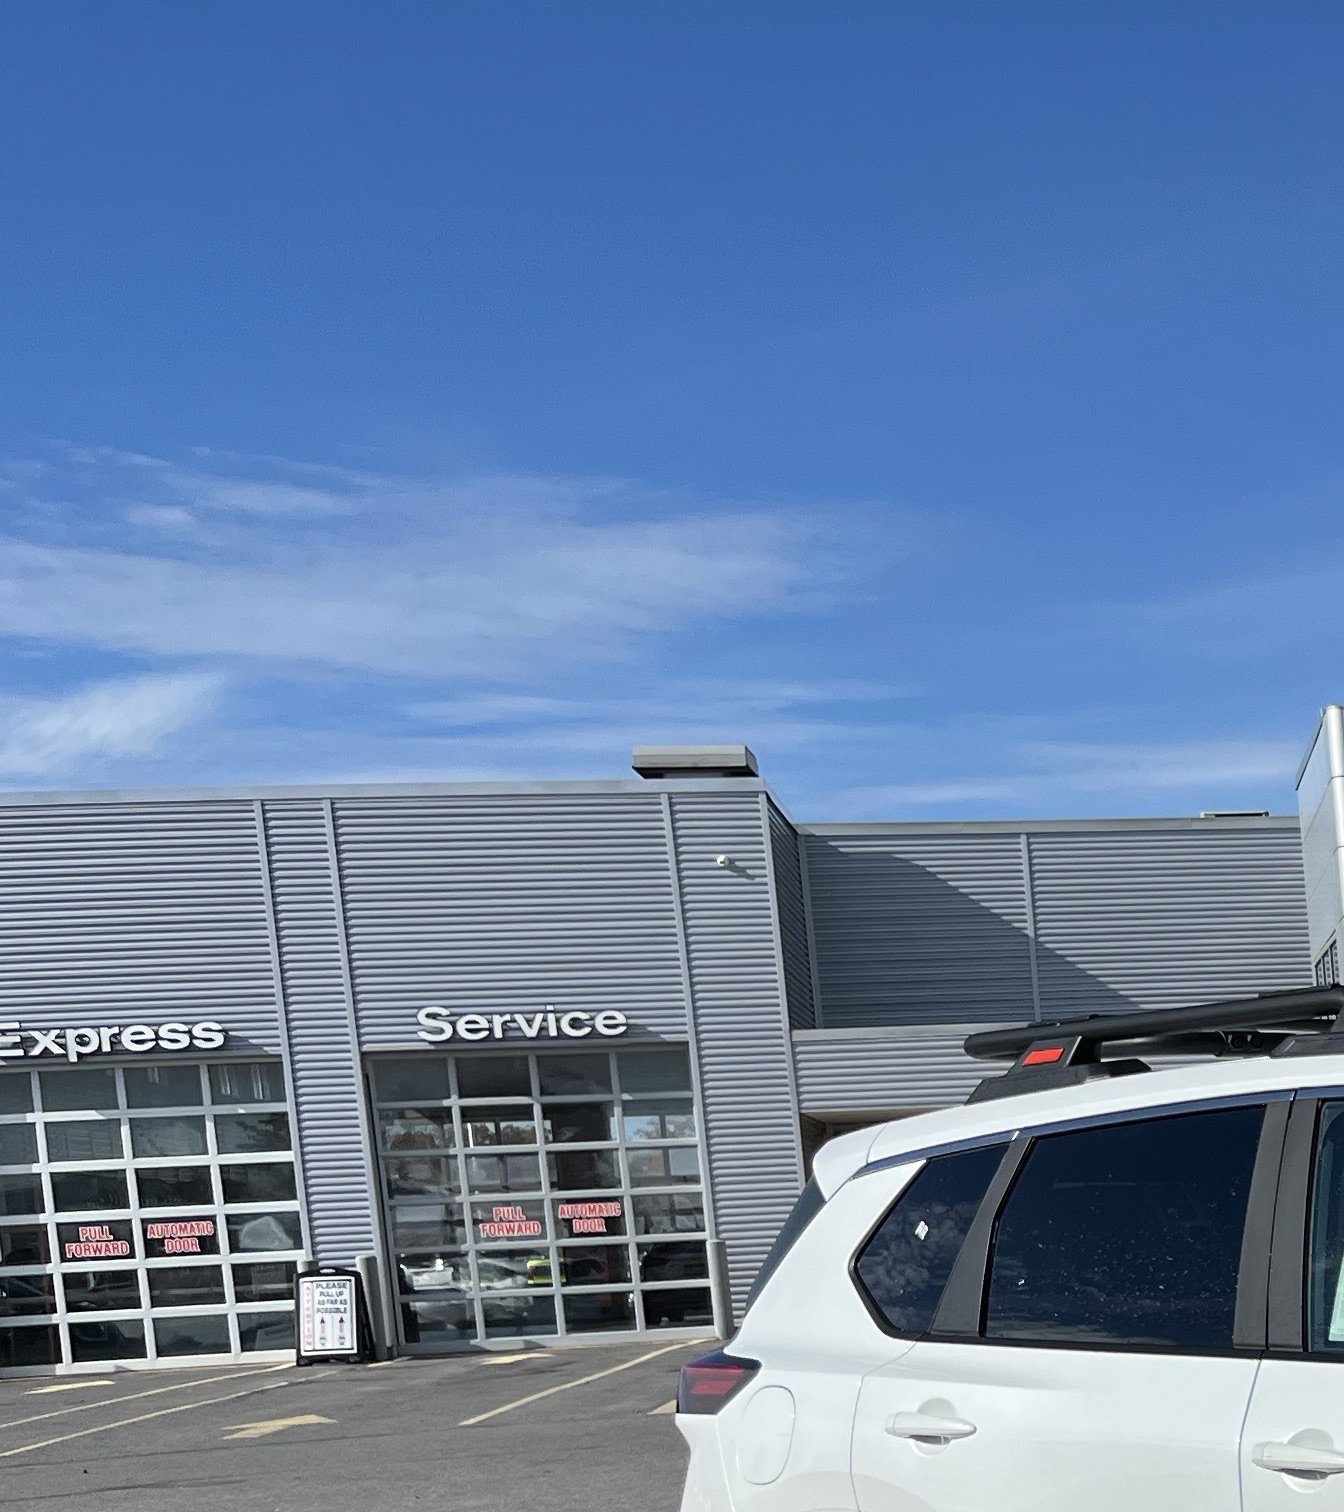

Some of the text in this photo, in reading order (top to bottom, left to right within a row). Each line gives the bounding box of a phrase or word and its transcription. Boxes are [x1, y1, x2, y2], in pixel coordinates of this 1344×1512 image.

[416, 1004, 628, 1042] Service
[492, 1206, 526, 1221] PULL
[558, 1202, 622, 1218] AUTOMATIC
[78, 1225, 114, 1241] PULL
[147, 1221, 215, 1239] AUTOMATIC
[479, 1221, 542, 1238] FORWARD
[573, 1218, 607, 1234] DOOR
[65, 1240, 131, 1259] FORWARD
[164, 1238, 201, 1254] DOOR
